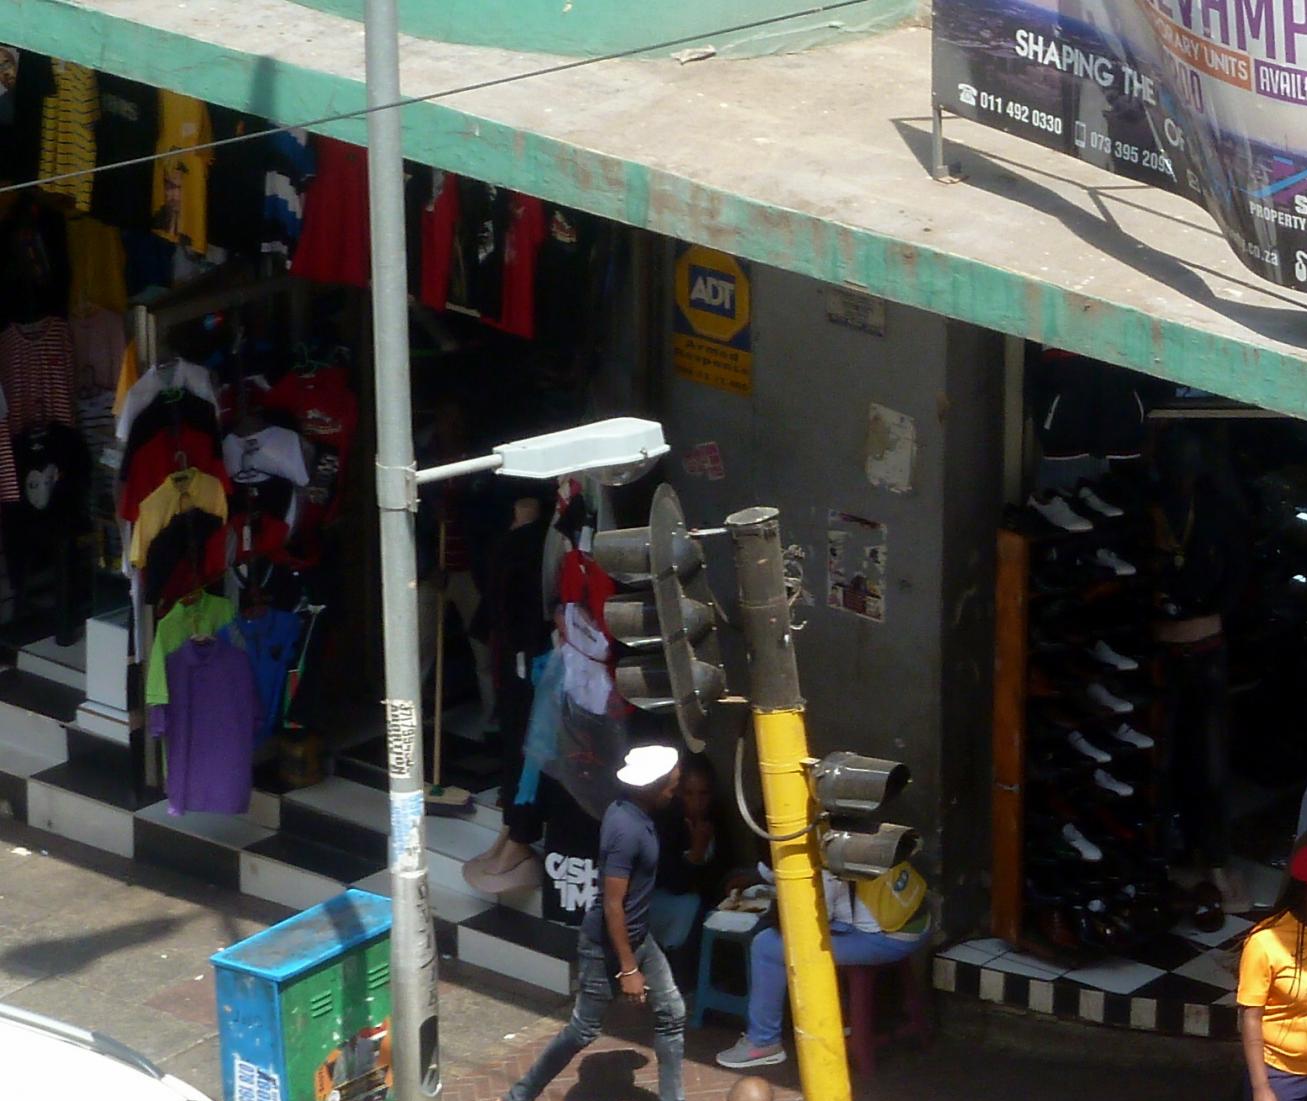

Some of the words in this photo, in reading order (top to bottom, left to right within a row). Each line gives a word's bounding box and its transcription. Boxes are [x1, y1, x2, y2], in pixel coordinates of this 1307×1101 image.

[1015, 29, 1115, 87] SHAPING
[1121, 64, 1157, 106] THE
[1204, 46, 1248, 80] UNITS
[980, 92, 1002, 114] 011
[1006, 101, 1029, 123] 492
[1032, 110, 1063, 135] 0330
[1090, 132, 1112, 154] 073
[1115, 141, 1139, 164] 395
[1249, 201, 1306, 231] PROPERTY
[690, 275, 735, 310] ADT
